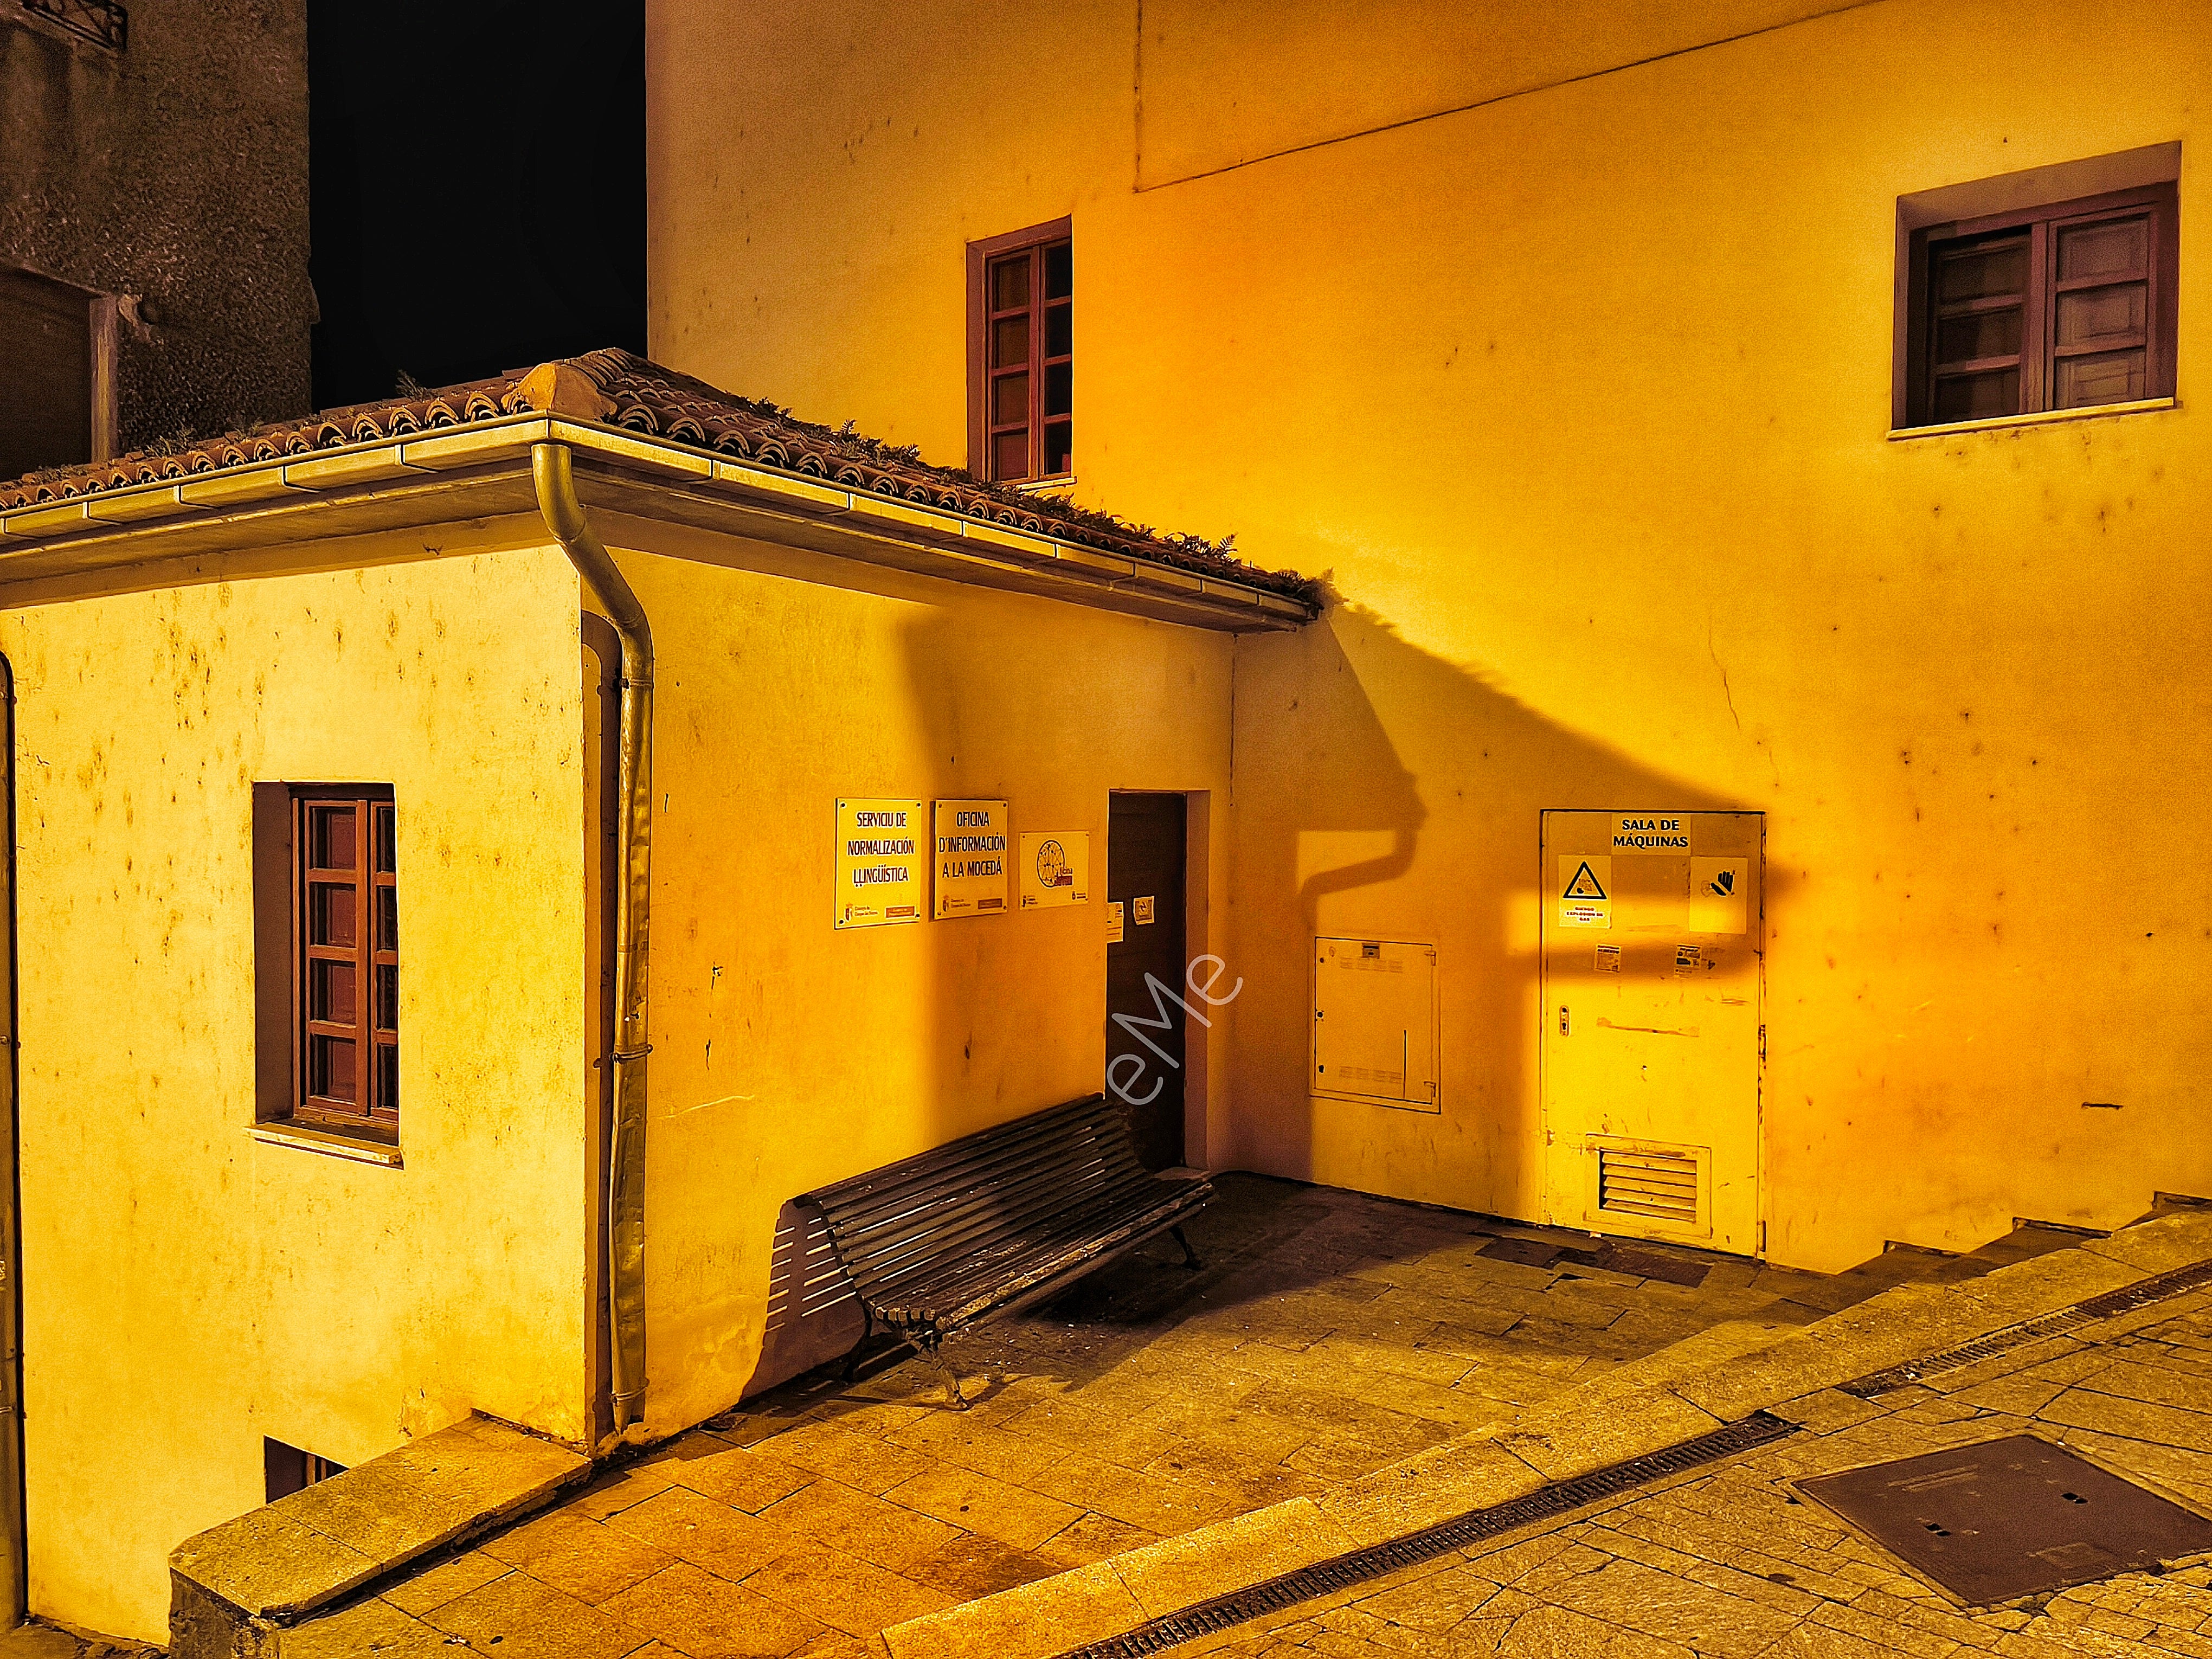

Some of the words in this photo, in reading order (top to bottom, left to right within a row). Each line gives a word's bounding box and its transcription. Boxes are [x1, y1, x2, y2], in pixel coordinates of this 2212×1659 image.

[857, 812, 893, 827] SERVICIU
[896, 812, 906, 827] DE
[956, 811, 989, 827] OFICINA
[1622, 819, 1656, 830] SALA
[1661, 819, 1680, 831] DE
[847, 836, 915, 856] NORMALIZACIÓN
[938, 832, 1006, 853] D'INFORMACIÓN
[1613, 832, 1688, 850] MÁQUINAS
[942, 862, 949, 878] A
[952, 861, 964, 877] LA
[967, 856, 1002, 877] MOCEDÁ
